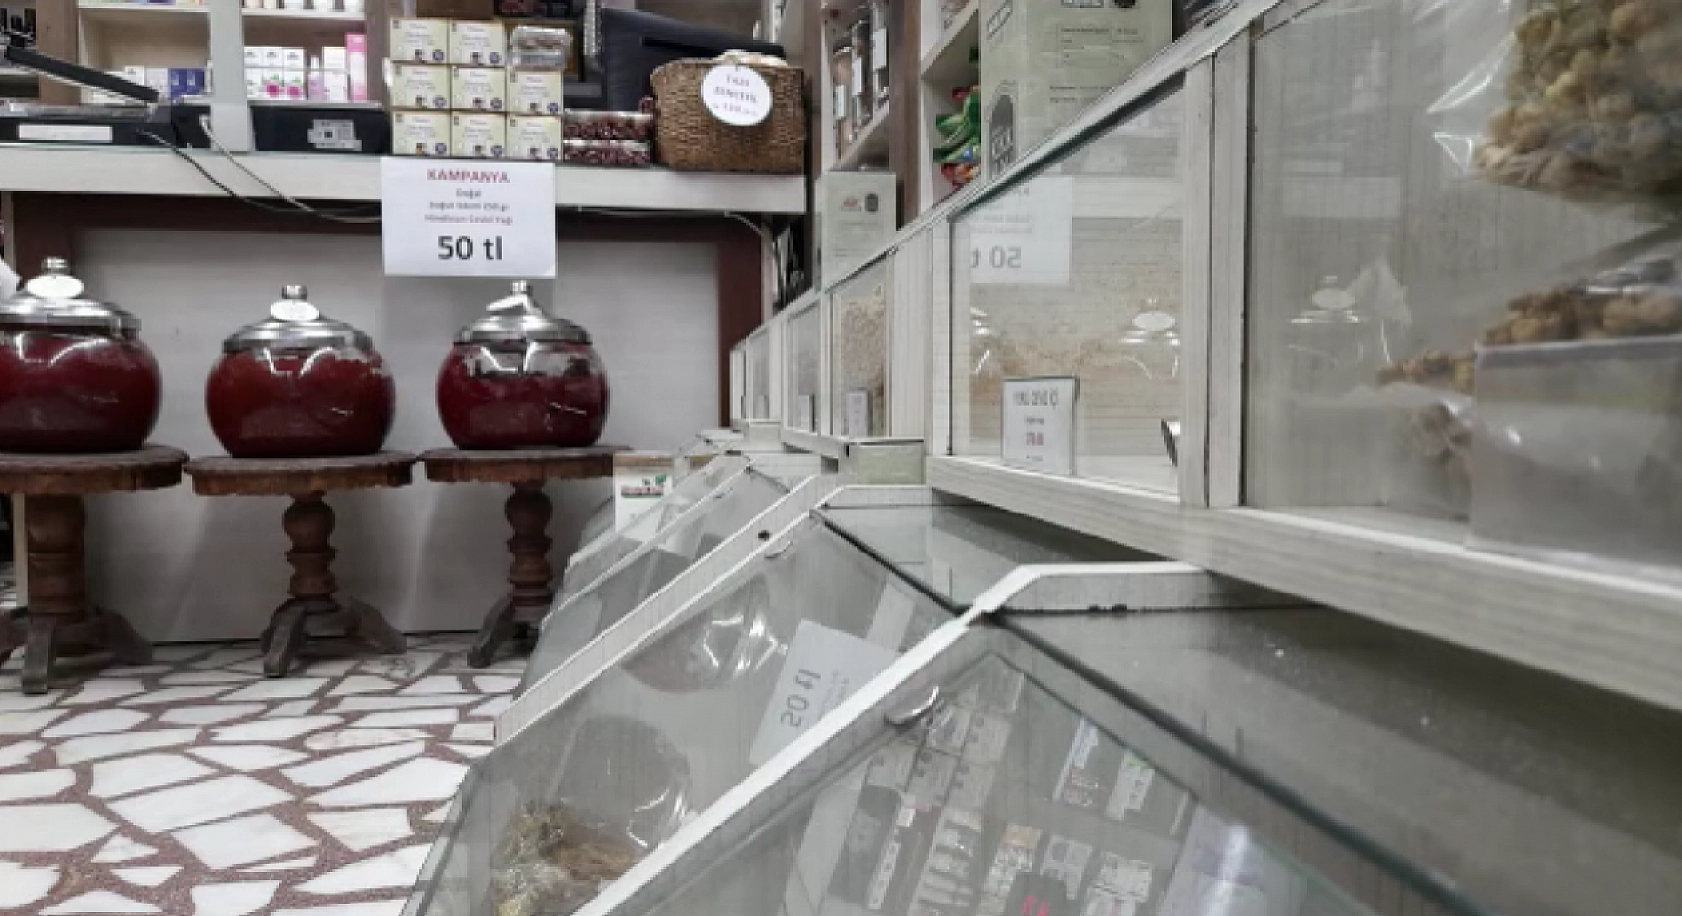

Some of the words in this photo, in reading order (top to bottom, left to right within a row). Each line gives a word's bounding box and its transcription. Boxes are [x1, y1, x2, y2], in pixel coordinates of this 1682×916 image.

[426, 168, 511, 183] KAMPANYA
[437, 235, 474, 260] 50
[482, 235, 503, 260] tl
